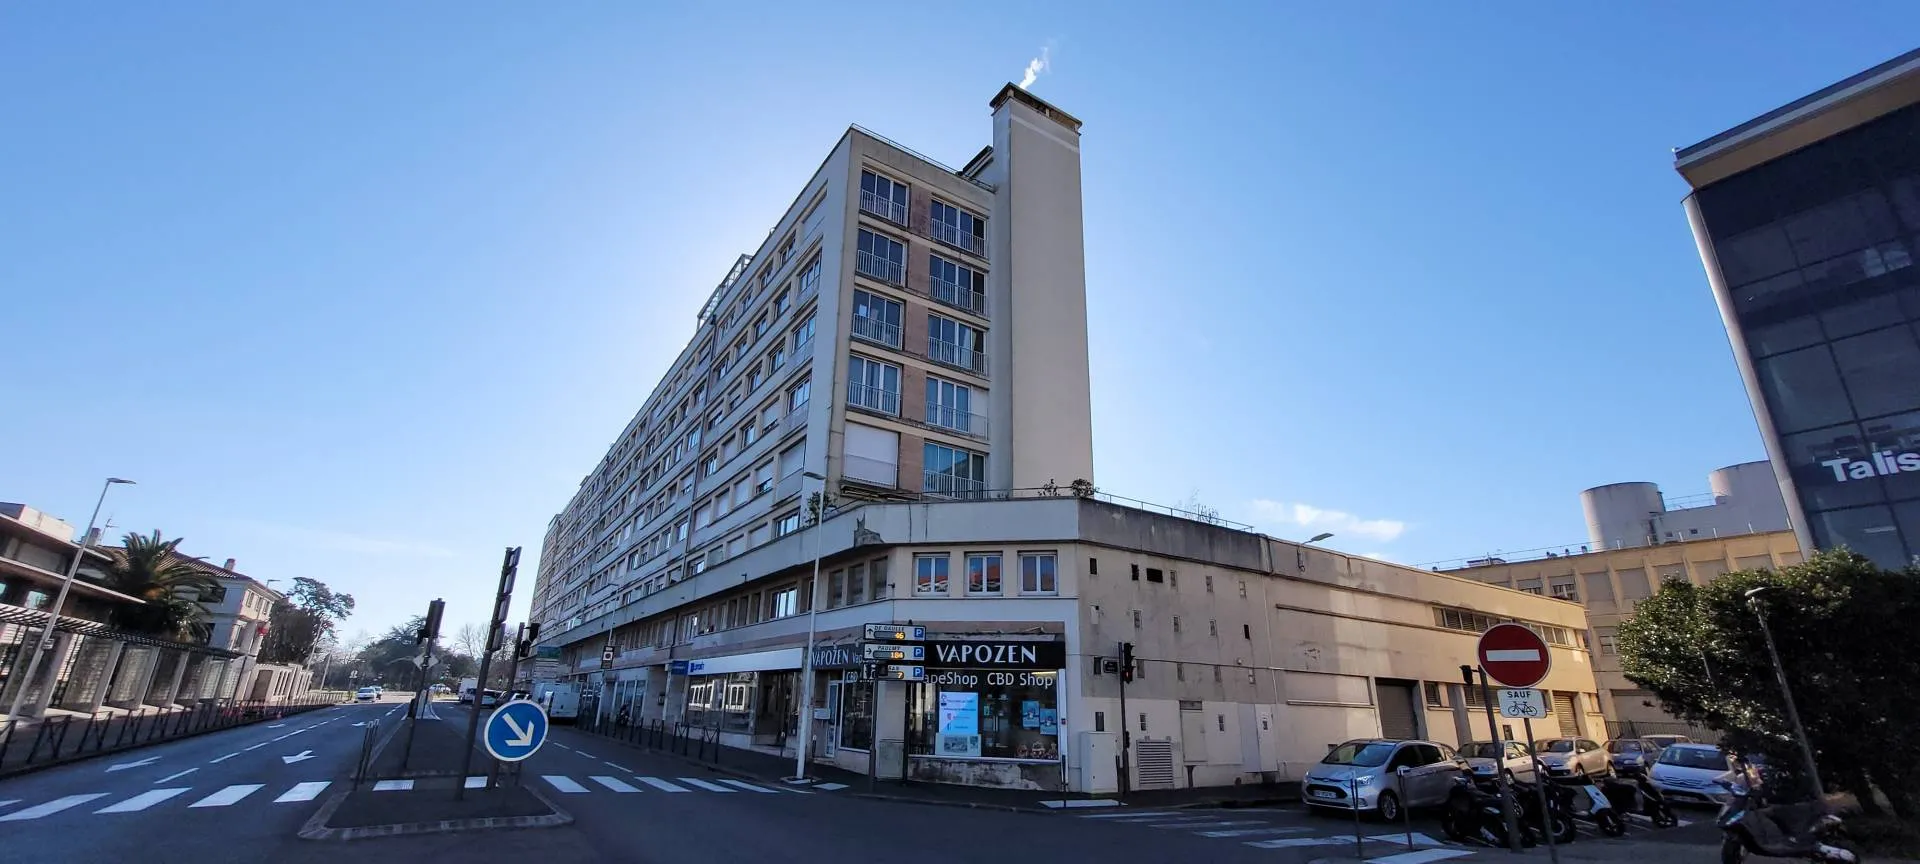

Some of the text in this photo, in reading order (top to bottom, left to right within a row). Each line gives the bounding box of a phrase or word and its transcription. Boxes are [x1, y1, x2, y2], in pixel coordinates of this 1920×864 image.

[1821, 450, 1920, 482] Talis
[812, 650, 849, 665] VAPOZEN
[936, 645, 1036, 663] VAPOZEN
[923, 672, 1053, 689] apeShop CBD Shop
